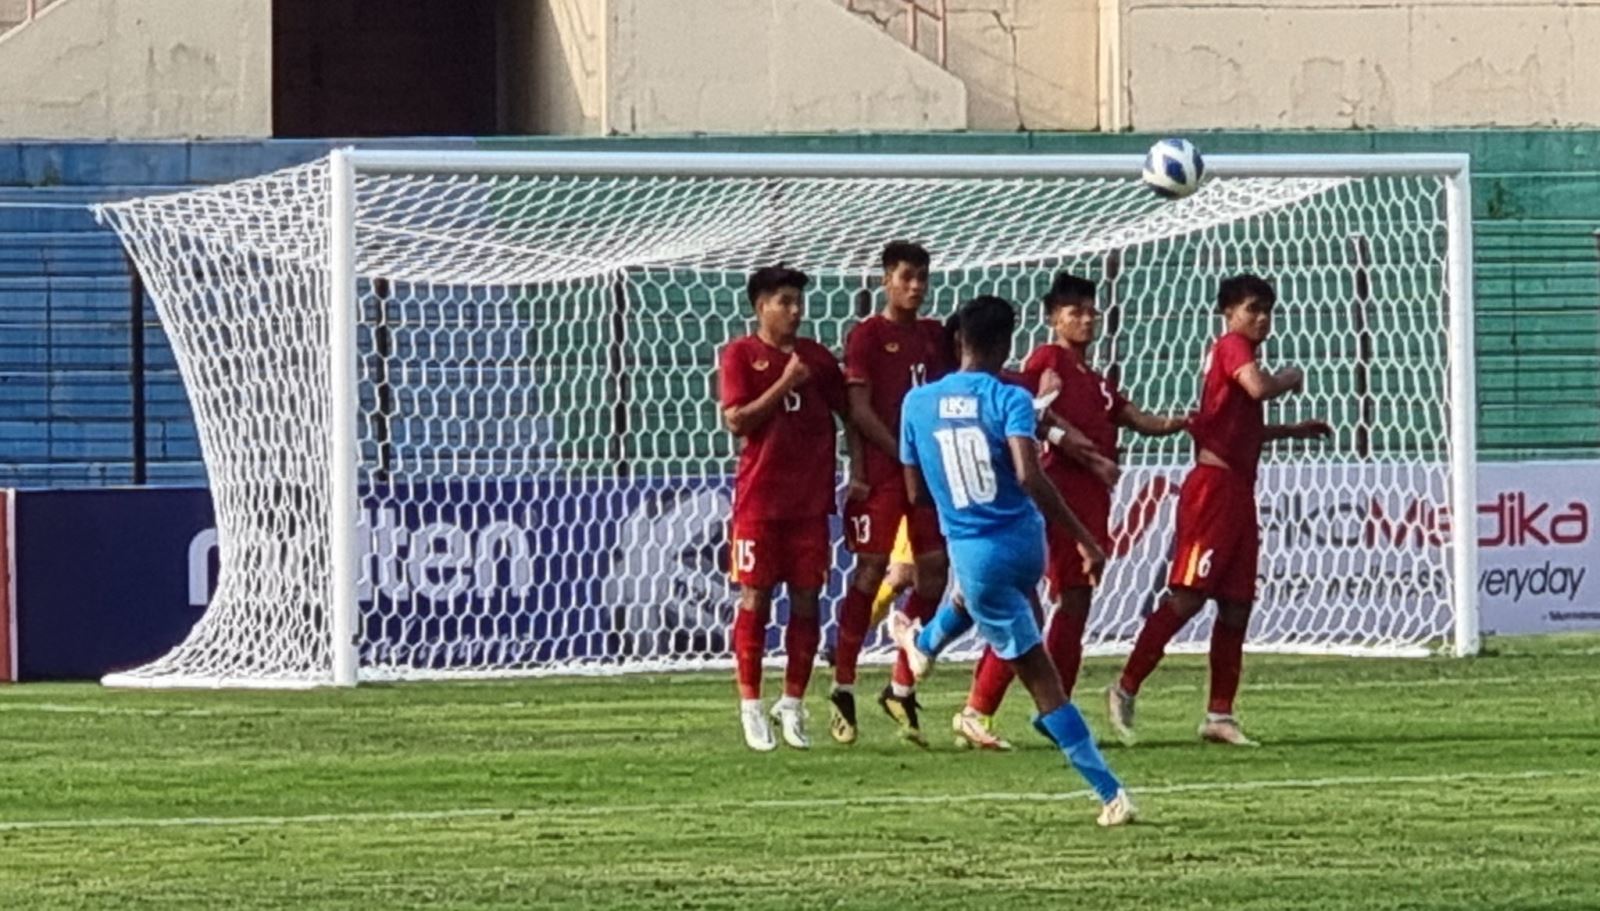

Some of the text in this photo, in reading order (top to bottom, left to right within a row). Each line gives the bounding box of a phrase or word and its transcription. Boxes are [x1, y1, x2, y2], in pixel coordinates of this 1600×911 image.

[850, 514, 871, 544] 13
[188, 507, 531, 606] mlten
[737, 539, 757, 573] 15
[1197, 548, 1214, 578] 6
